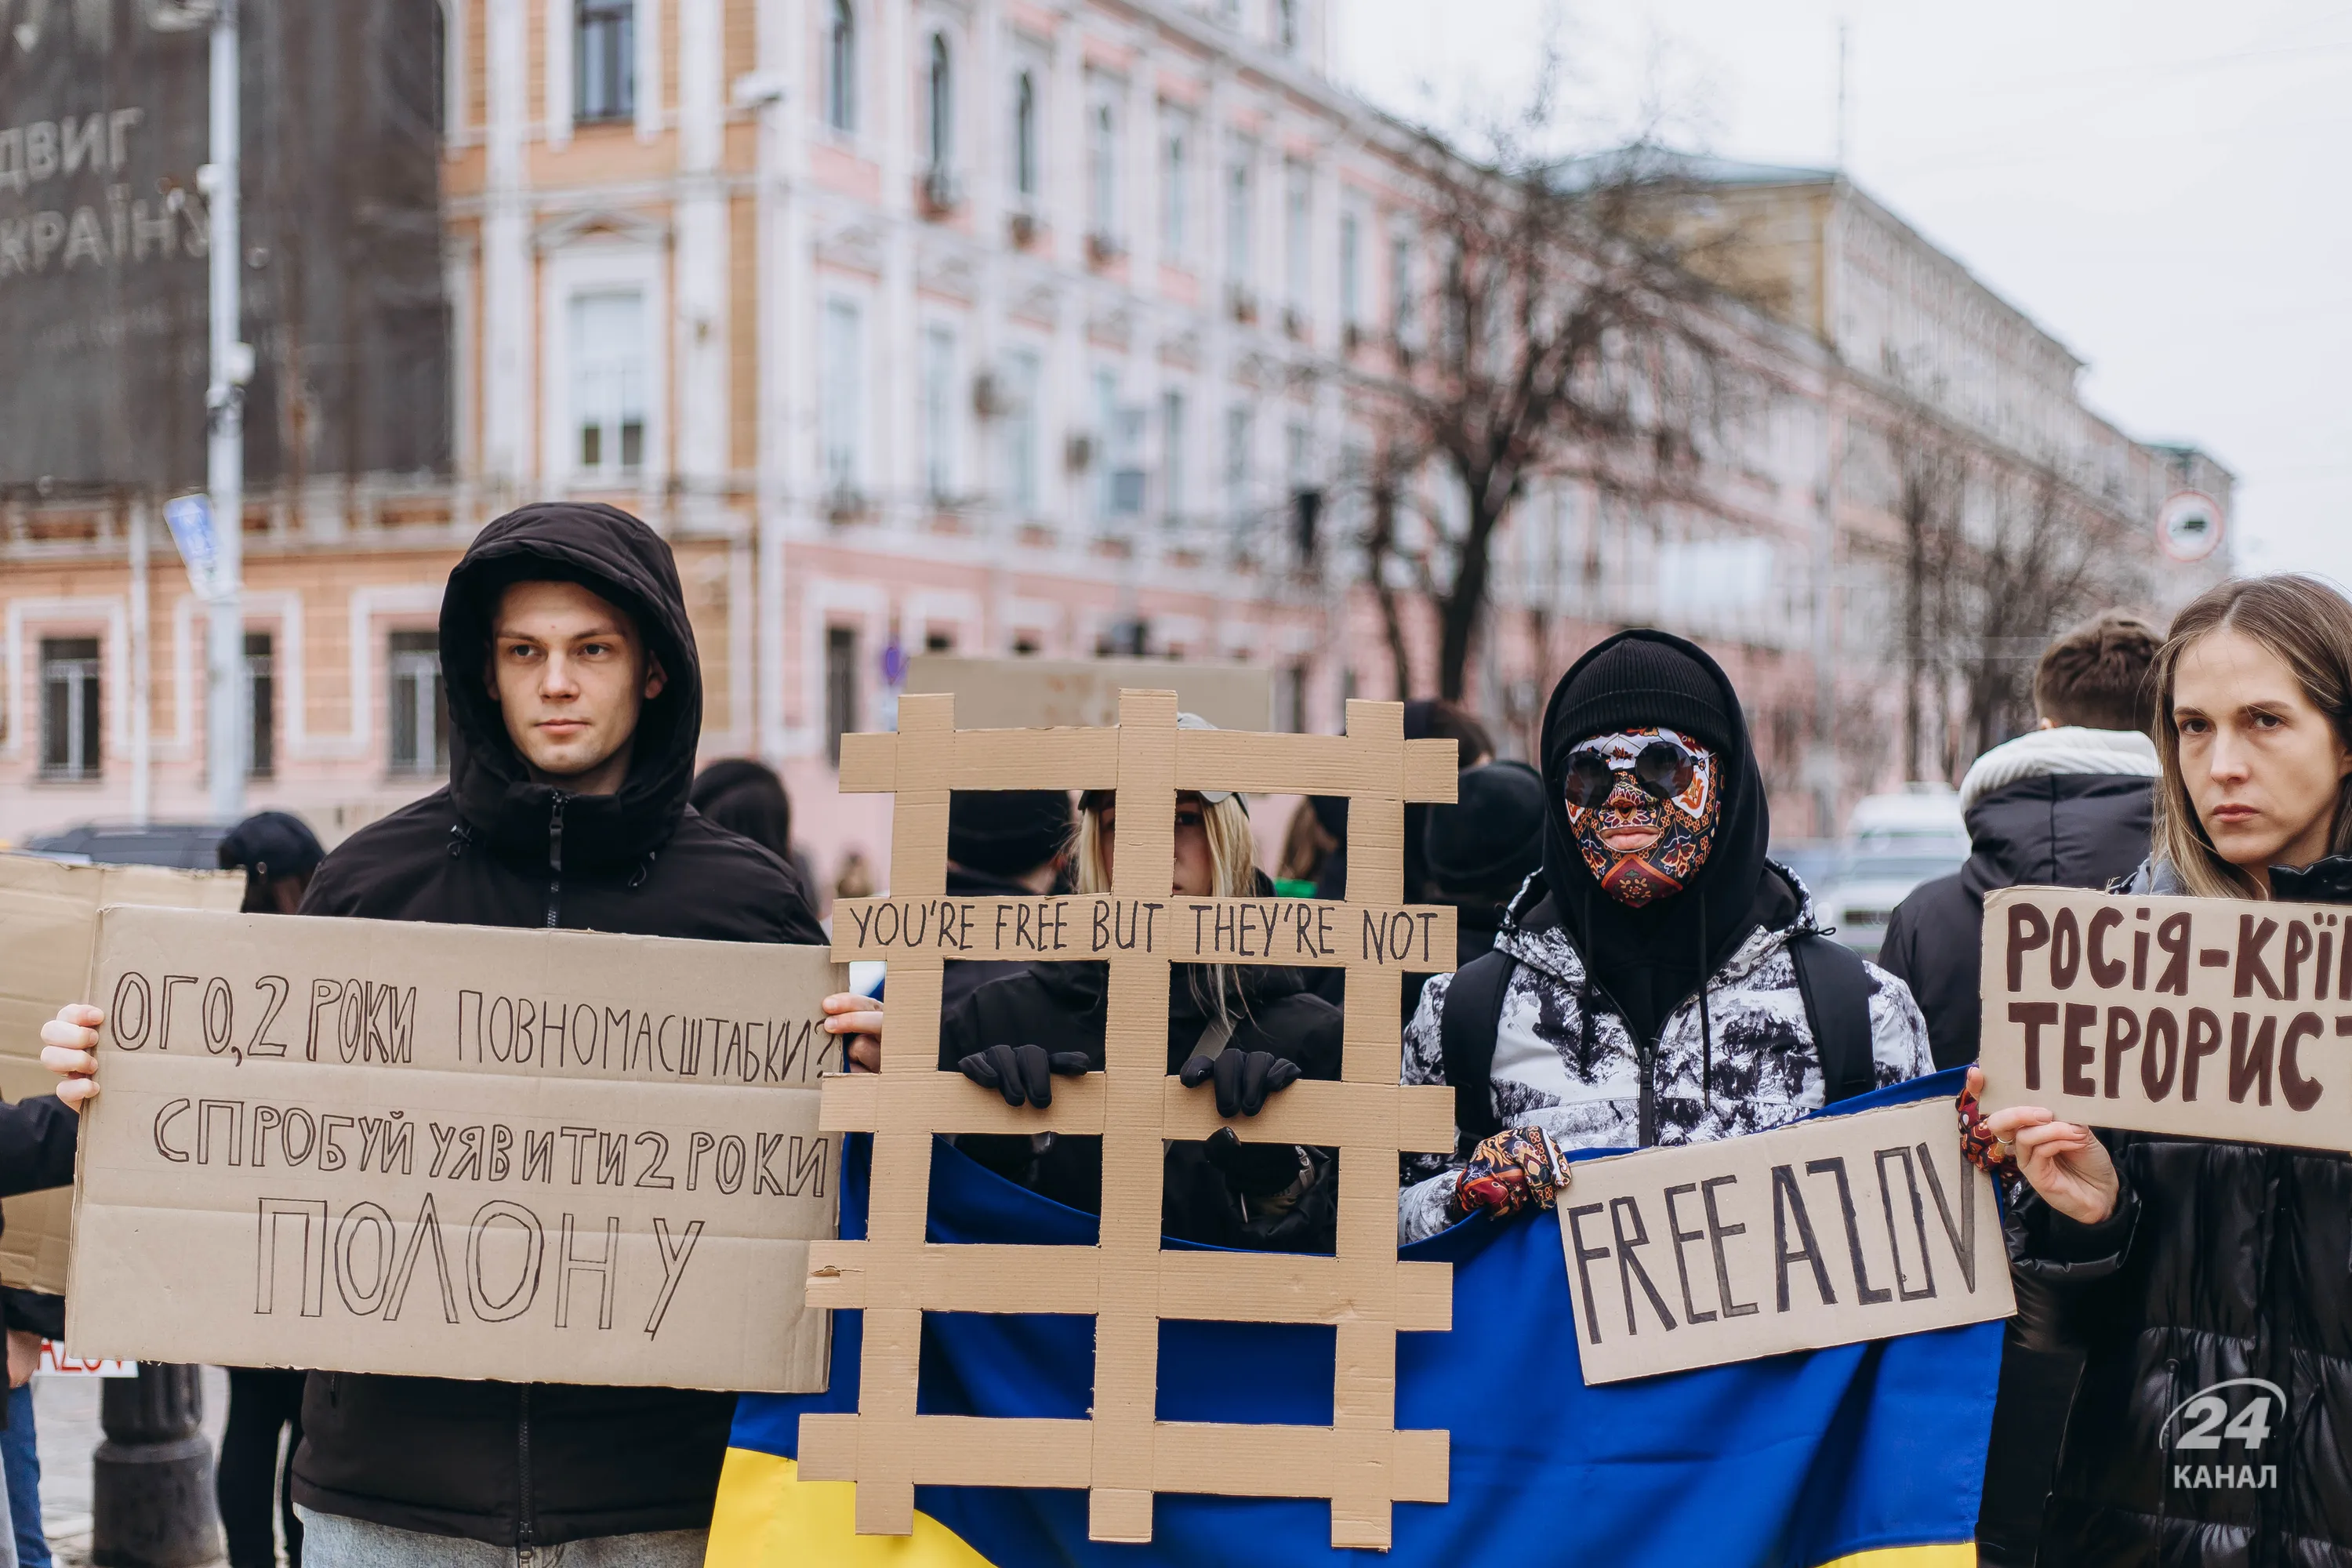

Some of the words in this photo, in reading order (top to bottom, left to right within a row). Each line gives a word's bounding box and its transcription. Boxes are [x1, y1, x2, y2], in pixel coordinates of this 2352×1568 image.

[849, 899, 975, 949] YOU'RE
[995, 901, 1069, 949] FREE
[1091, 899, 1164, 953] BUT
[1189, 903, 1335, 959] THEY'RE
[1363, 909, 1439, 965] NOT
[306, 978, 416, 1063] РОКИ
[154, 1098, 415, 1175] СПРОБУЙ
[686, 1131, 829, 1198] РОКИ
[254, 1192, 706, 1341] ПОЛОНУ
[1567, 1174, 1760, 1345] FREE
[1771, 1138, 1976, 1313] AZOV
